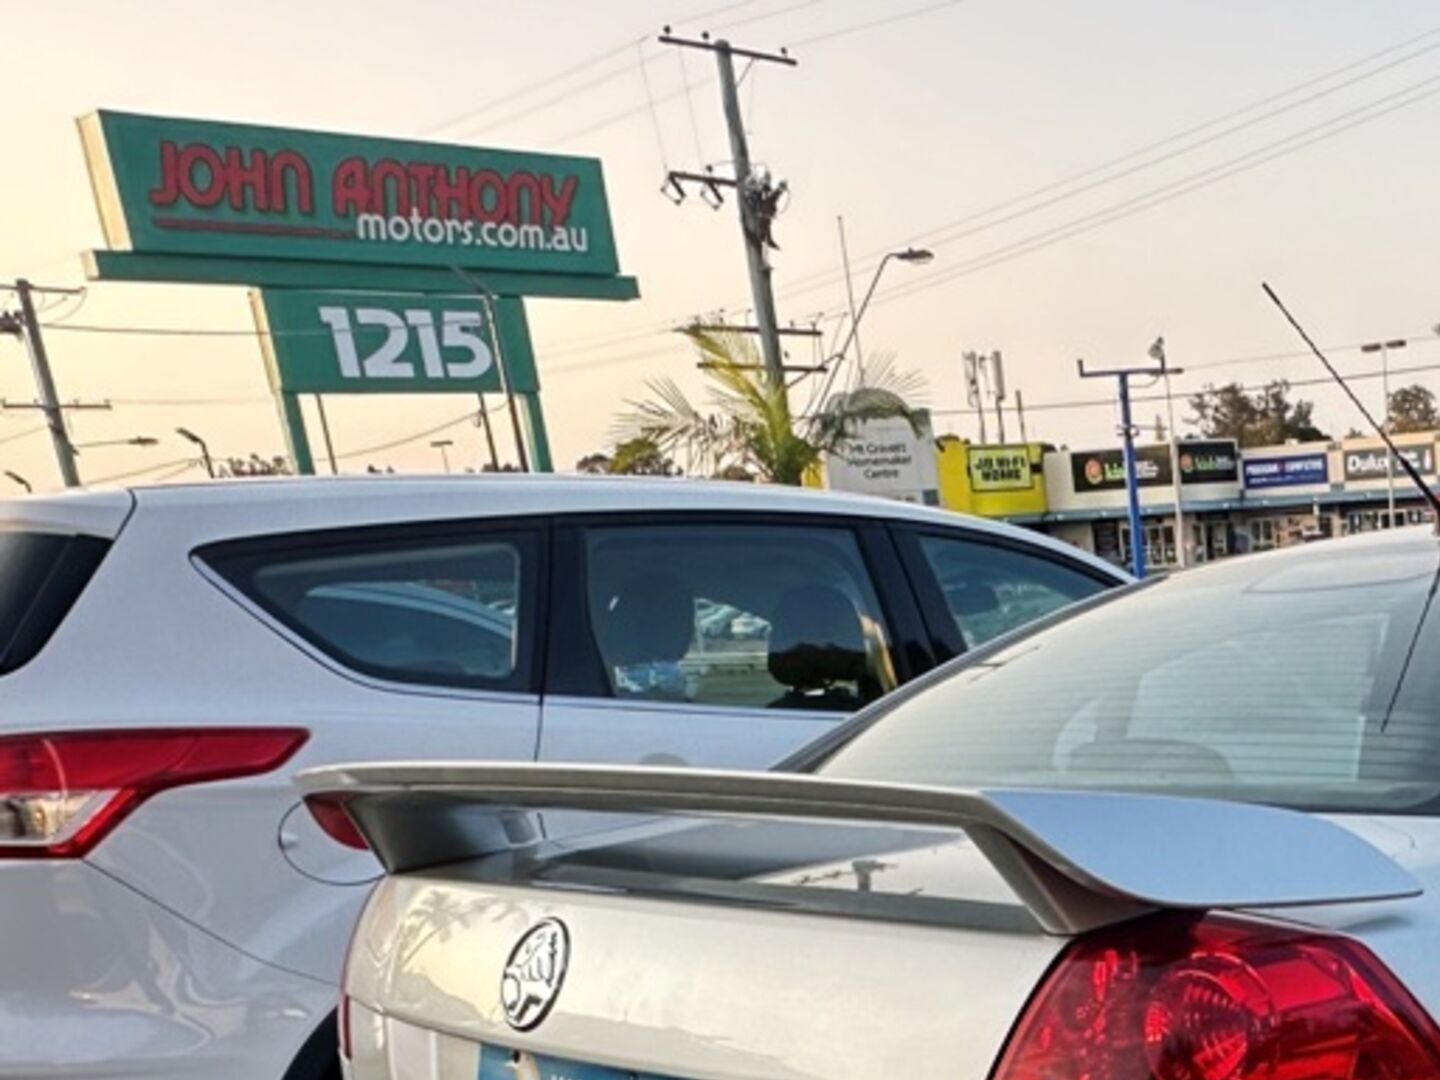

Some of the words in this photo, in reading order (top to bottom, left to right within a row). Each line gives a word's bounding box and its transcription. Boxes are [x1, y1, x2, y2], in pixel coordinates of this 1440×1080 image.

[150, 141, 315, 214] JOHN
[331, 157, 579, 230] ANTHONY
[357, 208, 590, 253] motors.com.au
[318, 306, 494, 379] 1215
